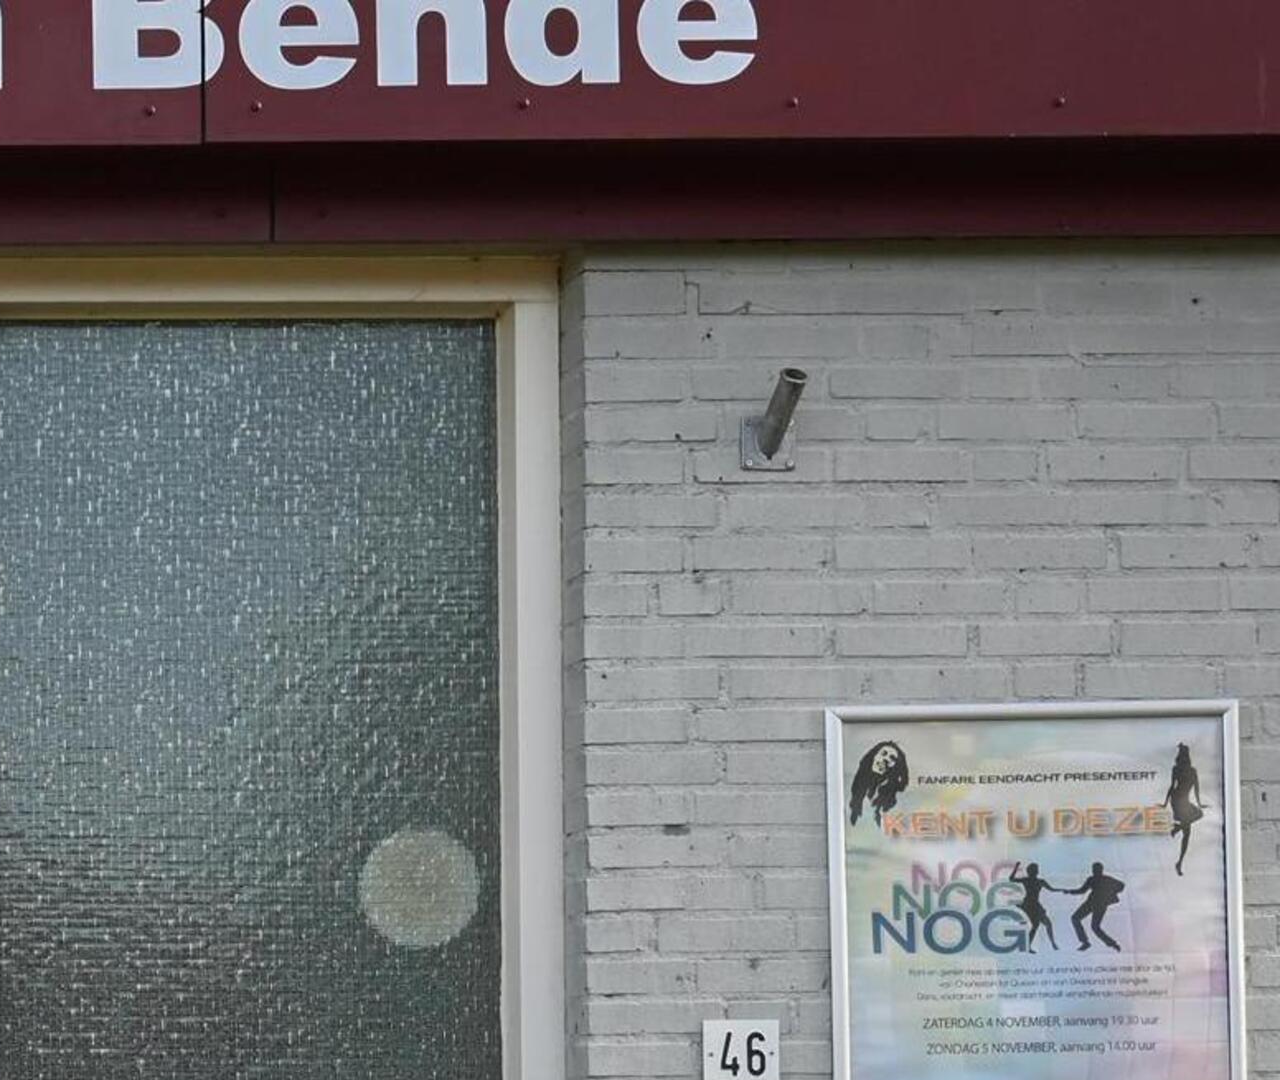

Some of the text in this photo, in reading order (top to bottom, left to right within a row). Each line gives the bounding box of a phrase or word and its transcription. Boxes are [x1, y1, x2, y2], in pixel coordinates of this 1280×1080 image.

[917, 771, 1158, 785] FANFARE EENDRACHT PRESENTEERT
[883, 805, 1171, 838] KENT U DEZE
[871, 908, 1027, 955] NOG
[922, 1017, 983, 1029] ZATERDAG
[1064, 1017, 1109, 1029] aanvang
[1140, 1016, 1159, 1026] uur
[720, 1031, 767, 1077] 46
[926, 1042, 980, 1055] ZONDAG
[1138, 1041, 1157, 1051] uur
